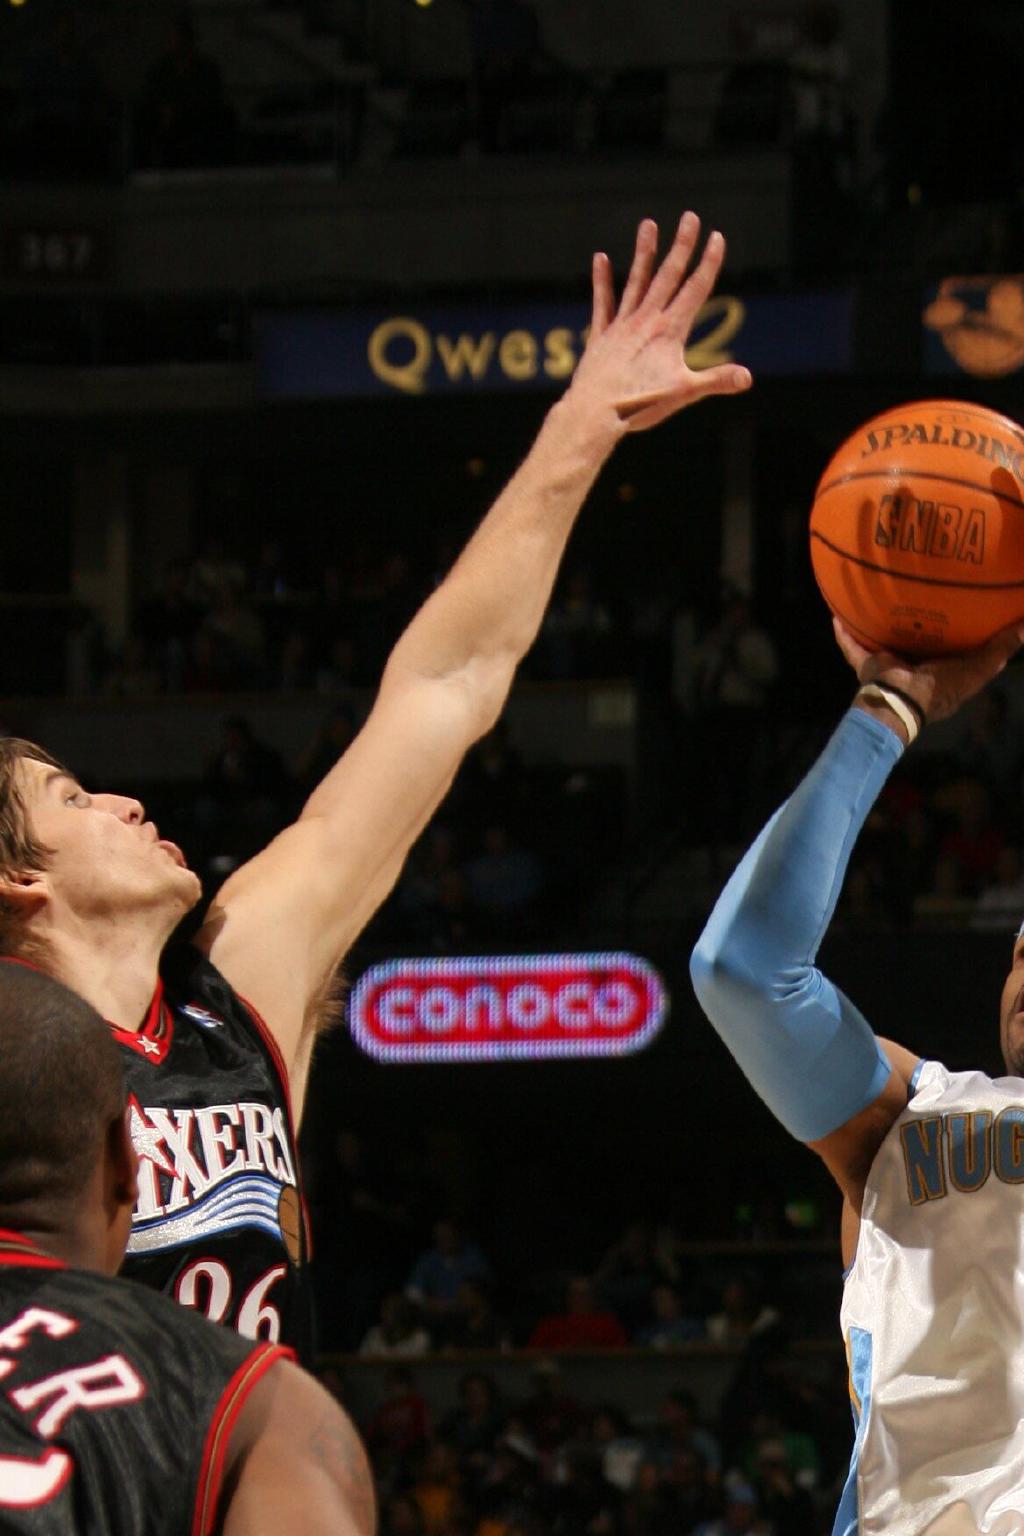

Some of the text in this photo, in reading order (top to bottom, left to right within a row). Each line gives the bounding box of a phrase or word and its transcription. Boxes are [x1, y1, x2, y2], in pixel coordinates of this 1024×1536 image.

[368, 316, 592, 396] Qwes
[378, 981, 638, 1035] conoco
[130, 1102, 297, 1222] IXERS
